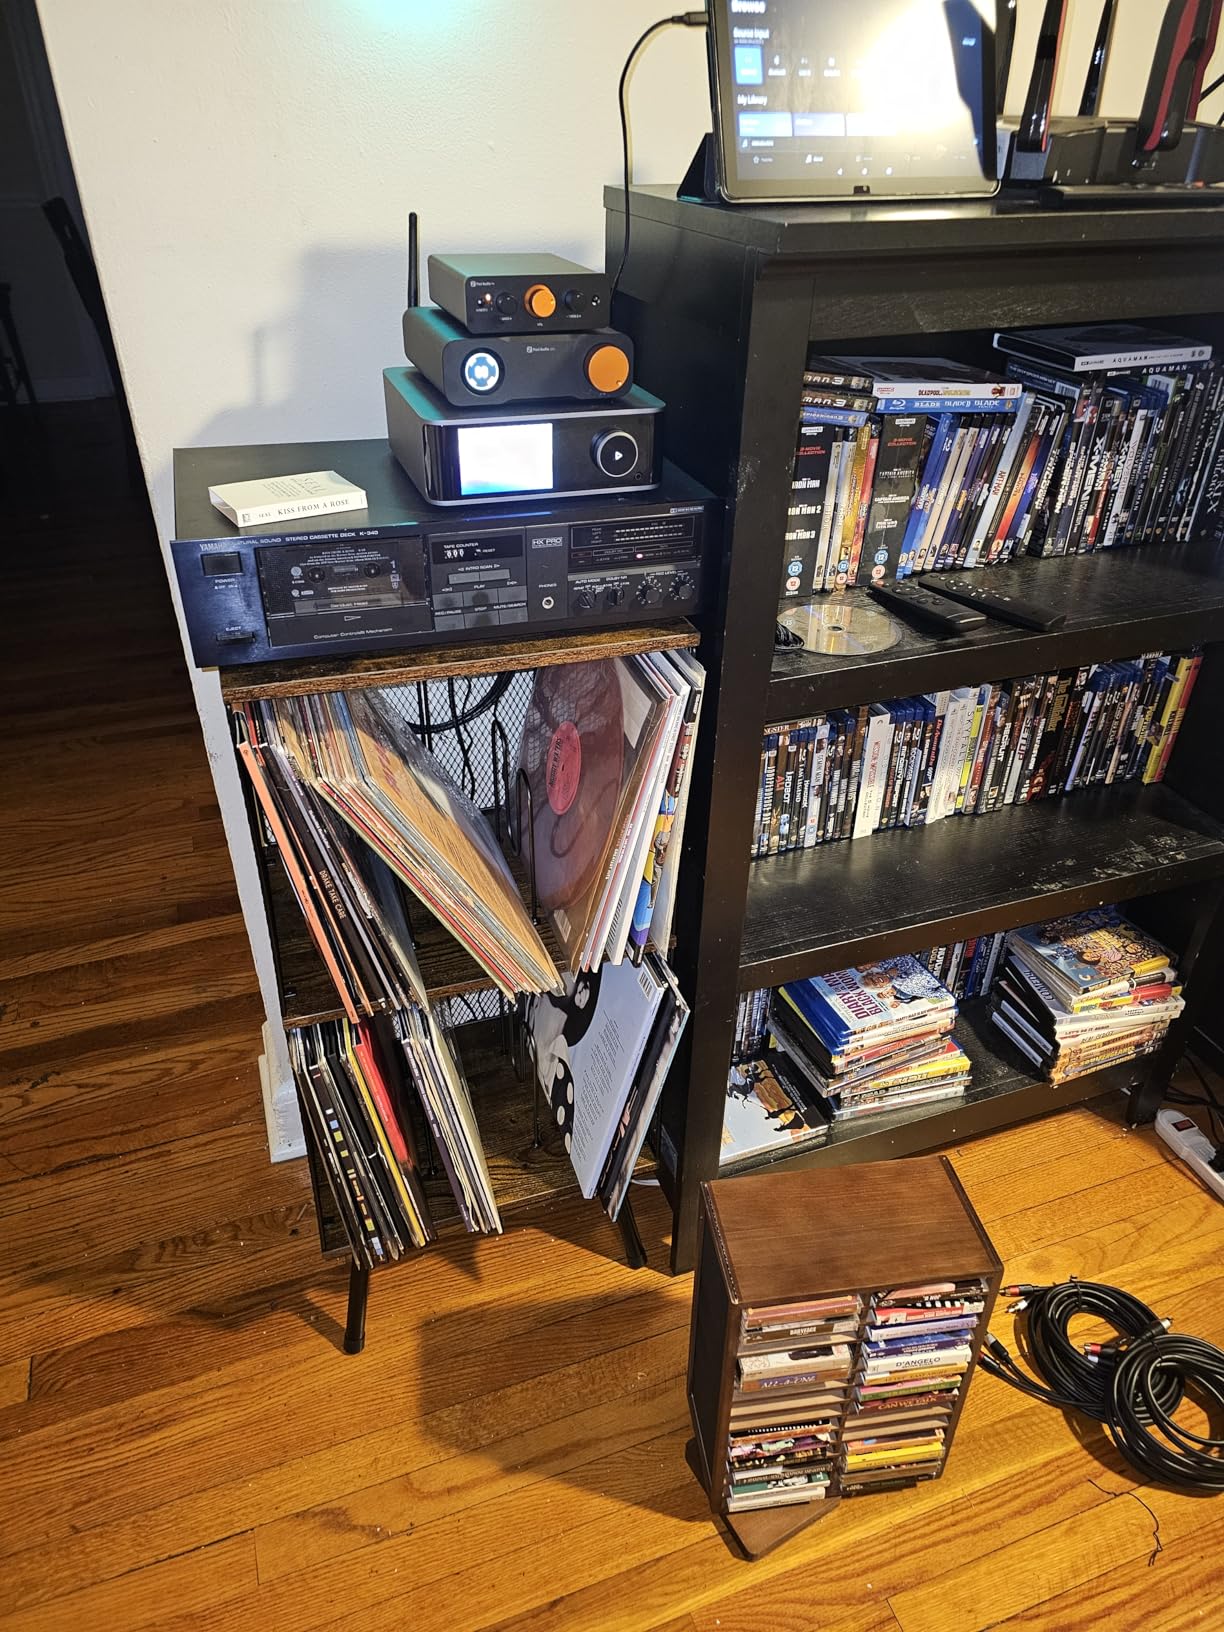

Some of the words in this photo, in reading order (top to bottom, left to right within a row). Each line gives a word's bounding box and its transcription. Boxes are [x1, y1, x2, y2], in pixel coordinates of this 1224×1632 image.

[1141, 363, 1188, 374] AQUAMAN
[1079, 435, 1106, 502] X-MEN
[1110, 440, 1130, 492] X-MEN
[277, 507, 295, 516] KISS
[298, 504, 319, 512] FROM
[330, 499, 349, 507] ROSE
[1058, 676, 1072, 696] The
[1047, 692, 1069, 734] Godfather
[956, 711, 974, 766] SKYFALL
[997, 721, 1012, 762] RECRUIT
[896, 745, 908, 779] MINORITY
[776, 775, 785, 791] ALI
[318, 869, 334, 890] DRAKE
[327, 888, 339, 904] TAKE
[334, 903, 347, 920] CARE
[835, 966, 861, 995] WOM
[836, 987, 870, 1021] DIARY
[852, 986, 882, 1016] BLACK
[896, 1357, 941, 1367] D'ANGELO
